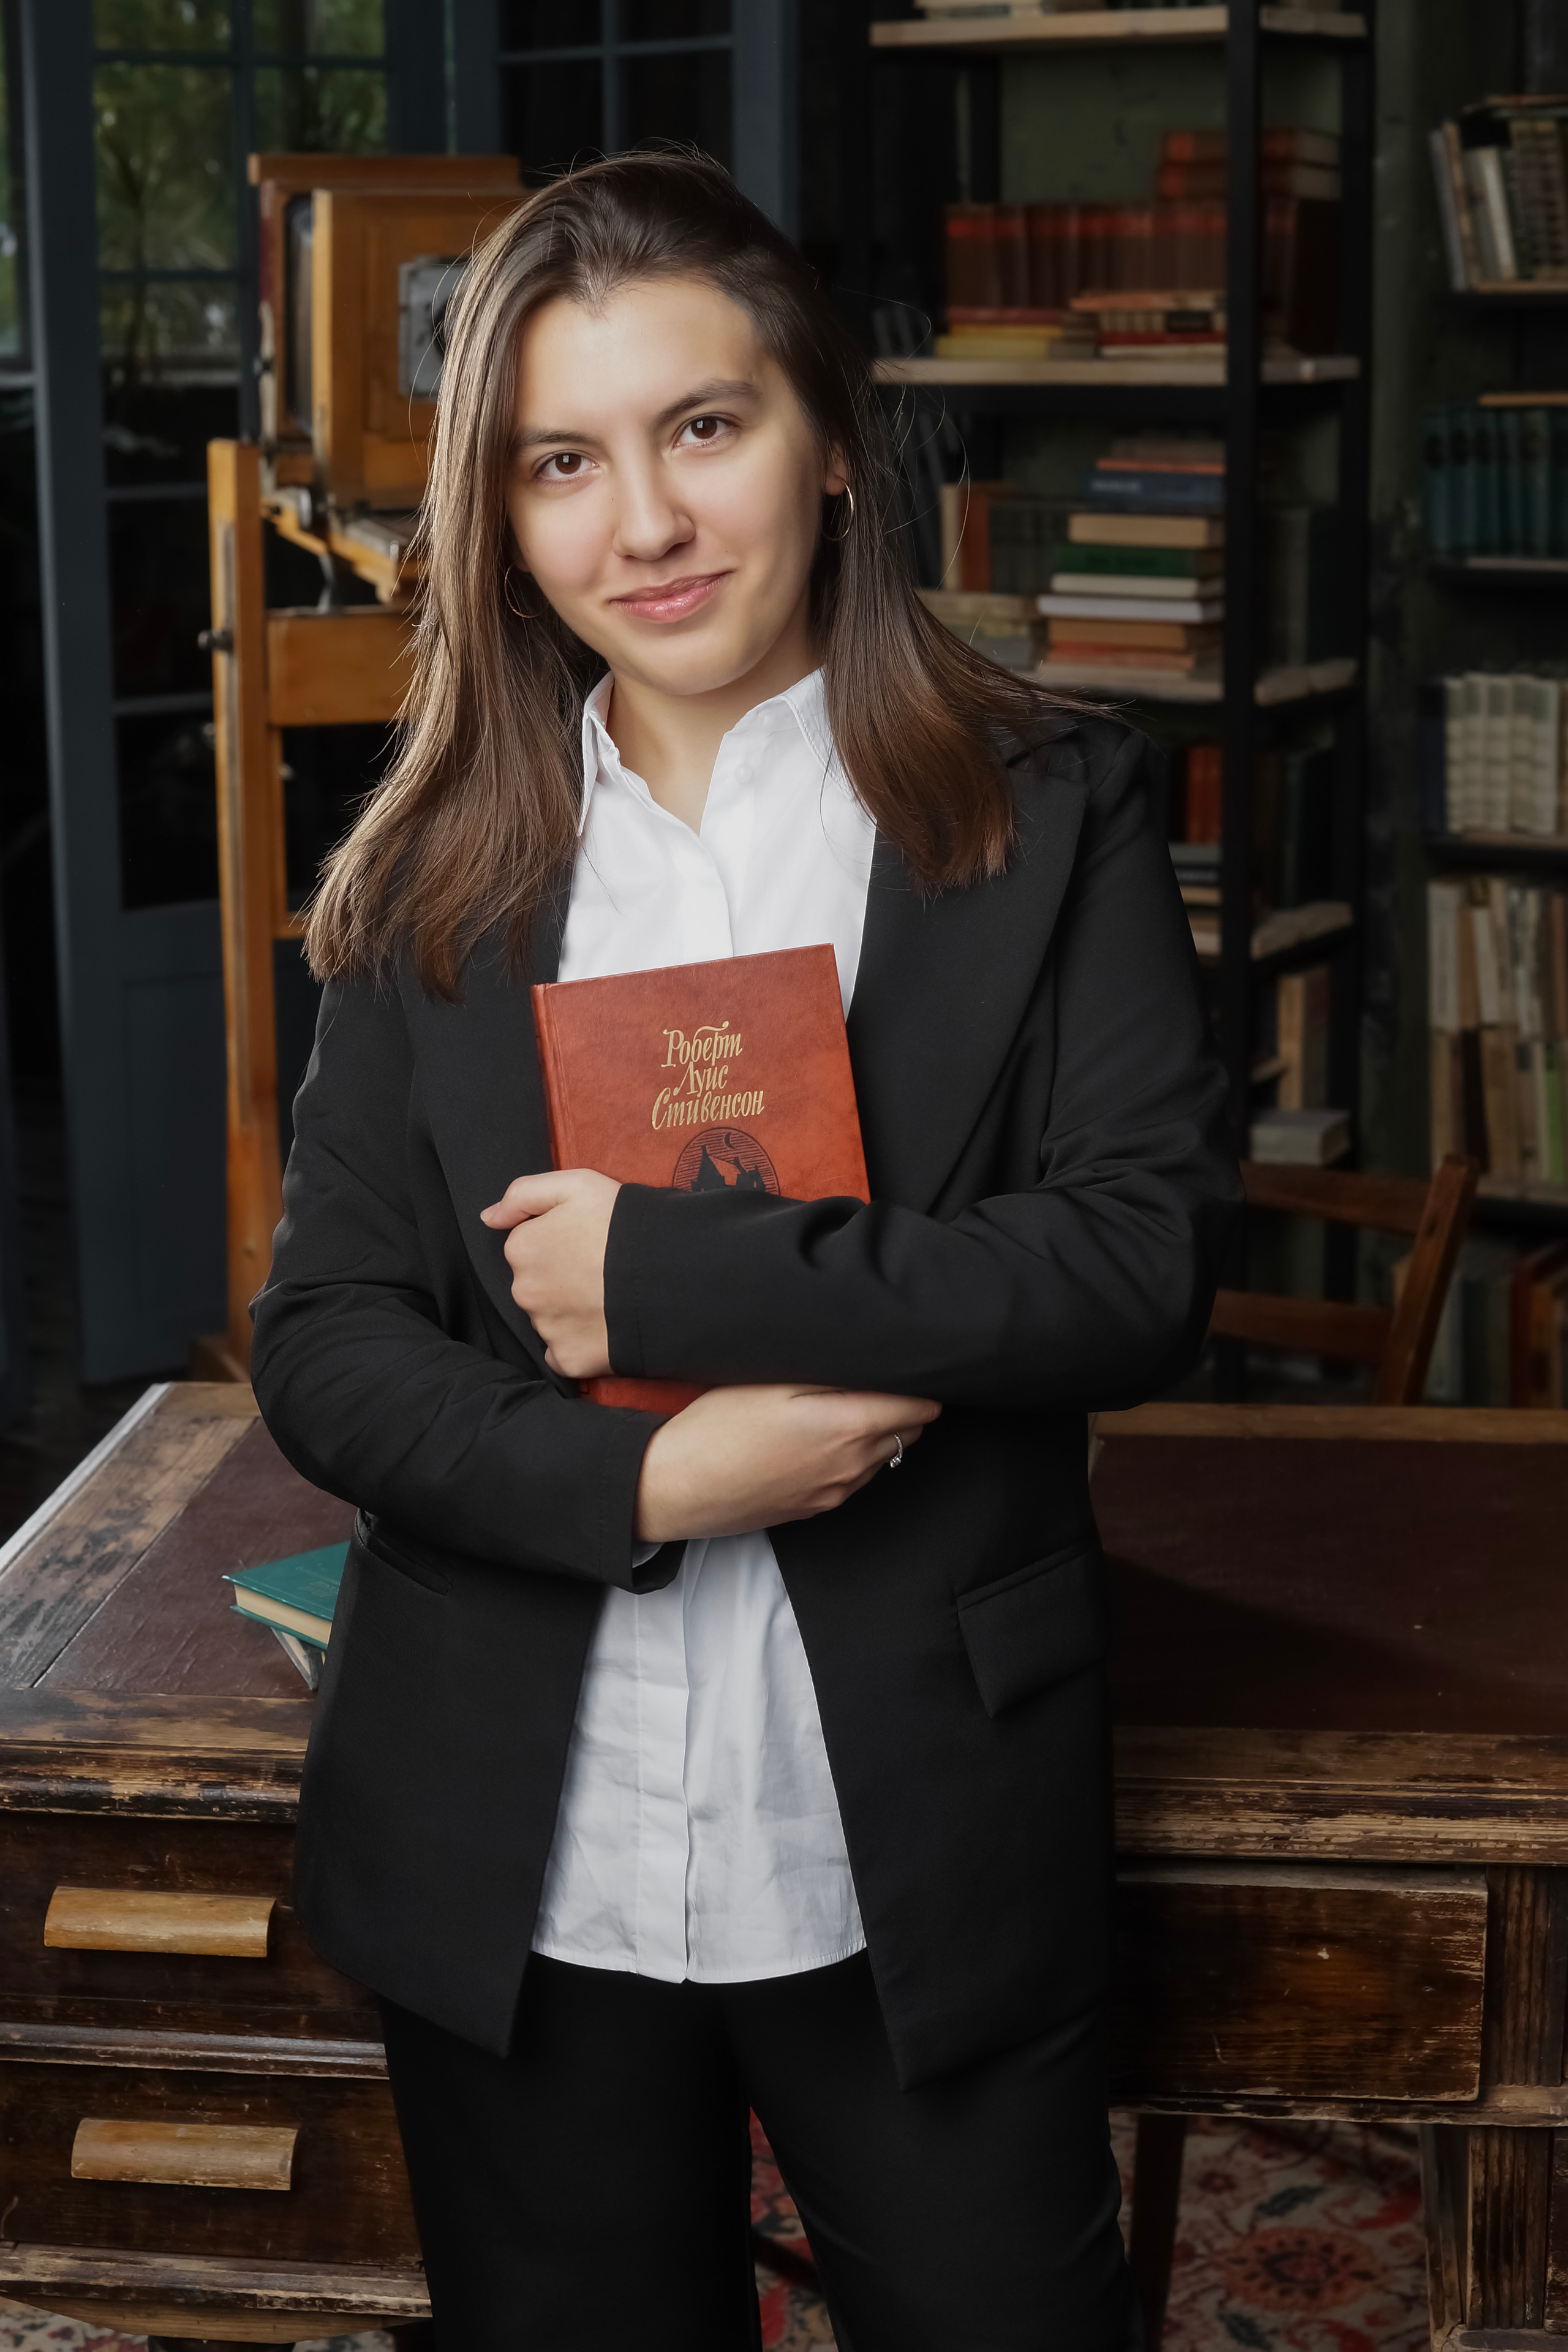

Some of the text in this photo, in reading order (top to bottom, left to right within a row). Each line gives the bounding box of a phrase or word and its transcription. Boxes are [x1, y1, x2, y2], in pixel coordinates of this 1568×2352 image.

[661, 1021, 743, 1068] Роберт
[673, 1061, 729, 1098] Луис
[652, 1087, 764, 1130] Стивенсон
